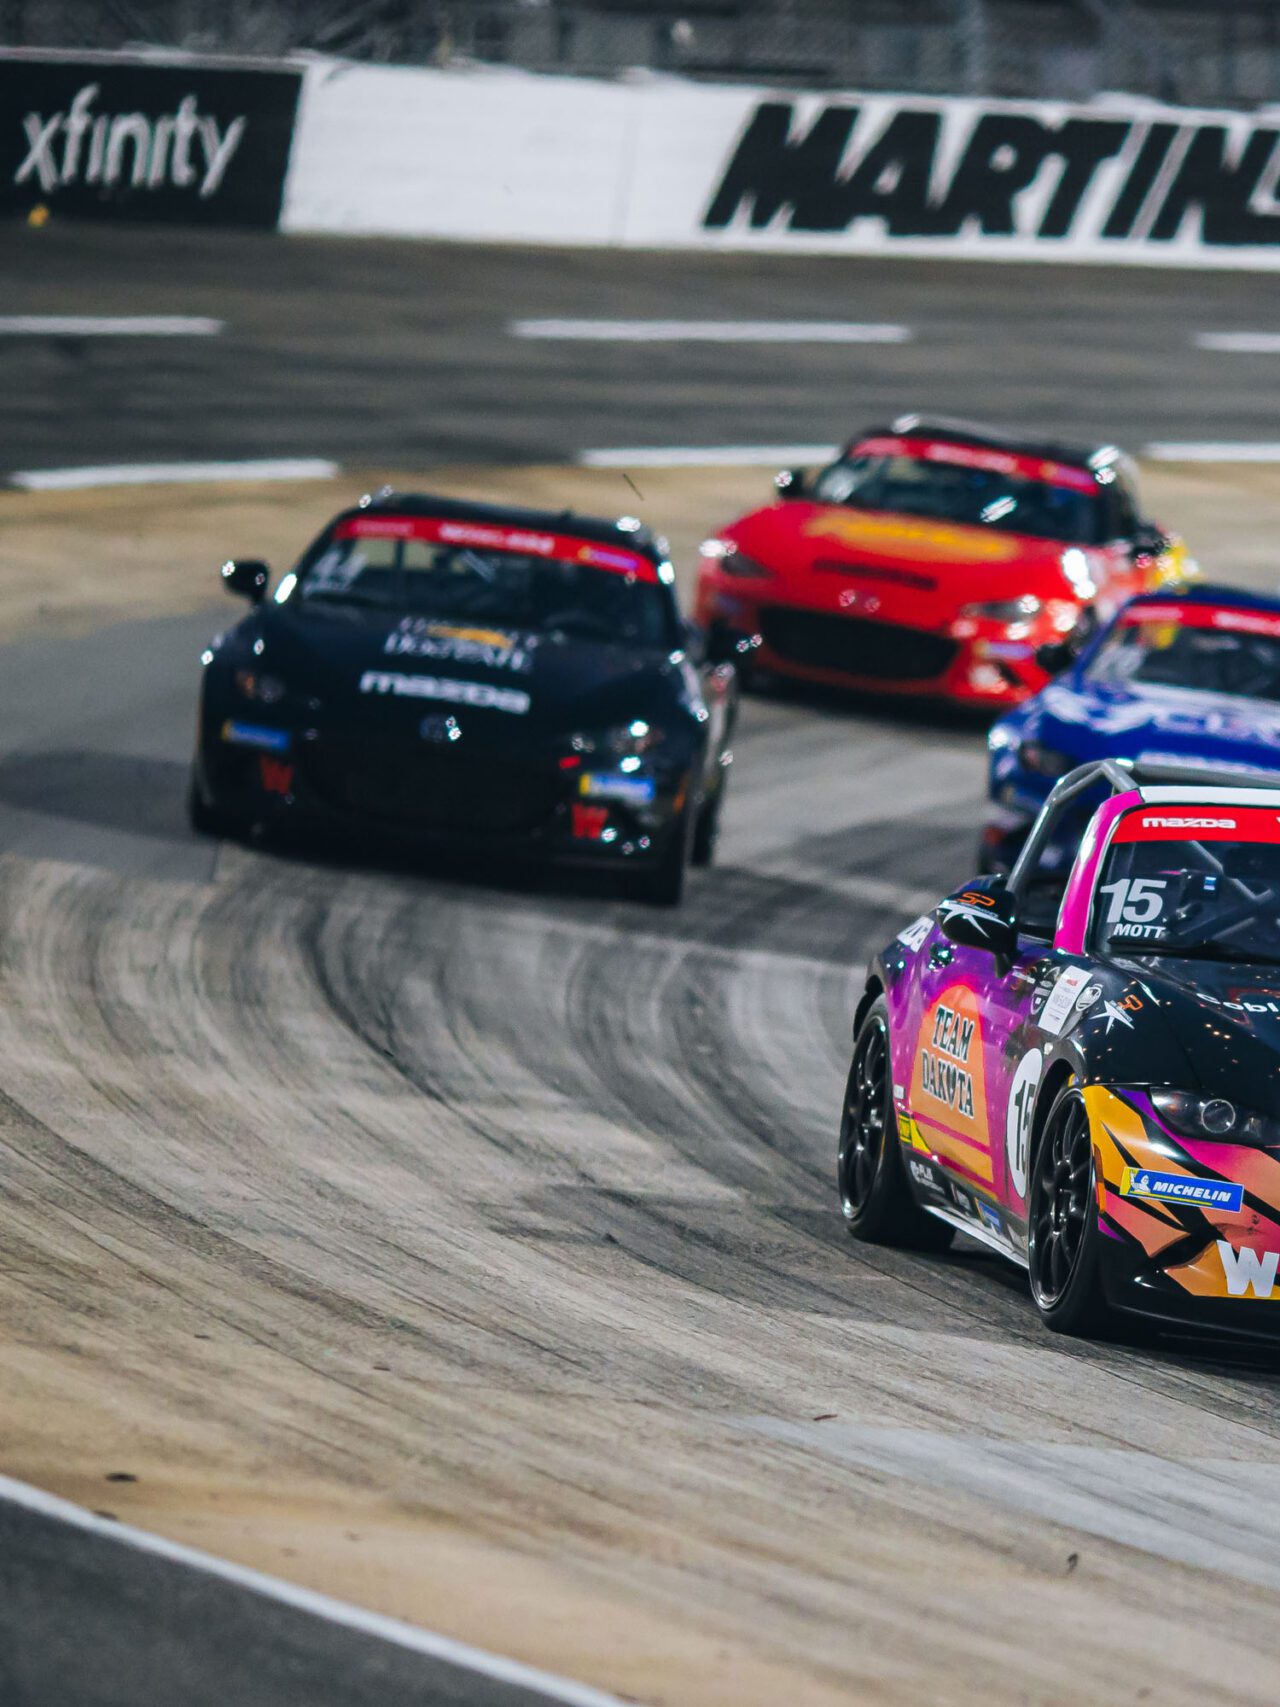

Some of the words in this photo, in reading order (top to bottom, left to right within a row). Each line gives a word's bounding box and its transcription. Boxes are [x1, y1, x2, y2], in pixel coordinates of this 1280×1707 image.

[15, 82, 247, 198] xfinity
[1141, 817, 1237, 829] mazda
[1098, 877, 1167, 924] 15
[1113, 922, 1166, 940] MOTT
[932, 1004, 975, 1063] TEAM
[1152, 1181, 1232, 1202] MICHELIN
[1216, 1239, 1280, 1297] W
